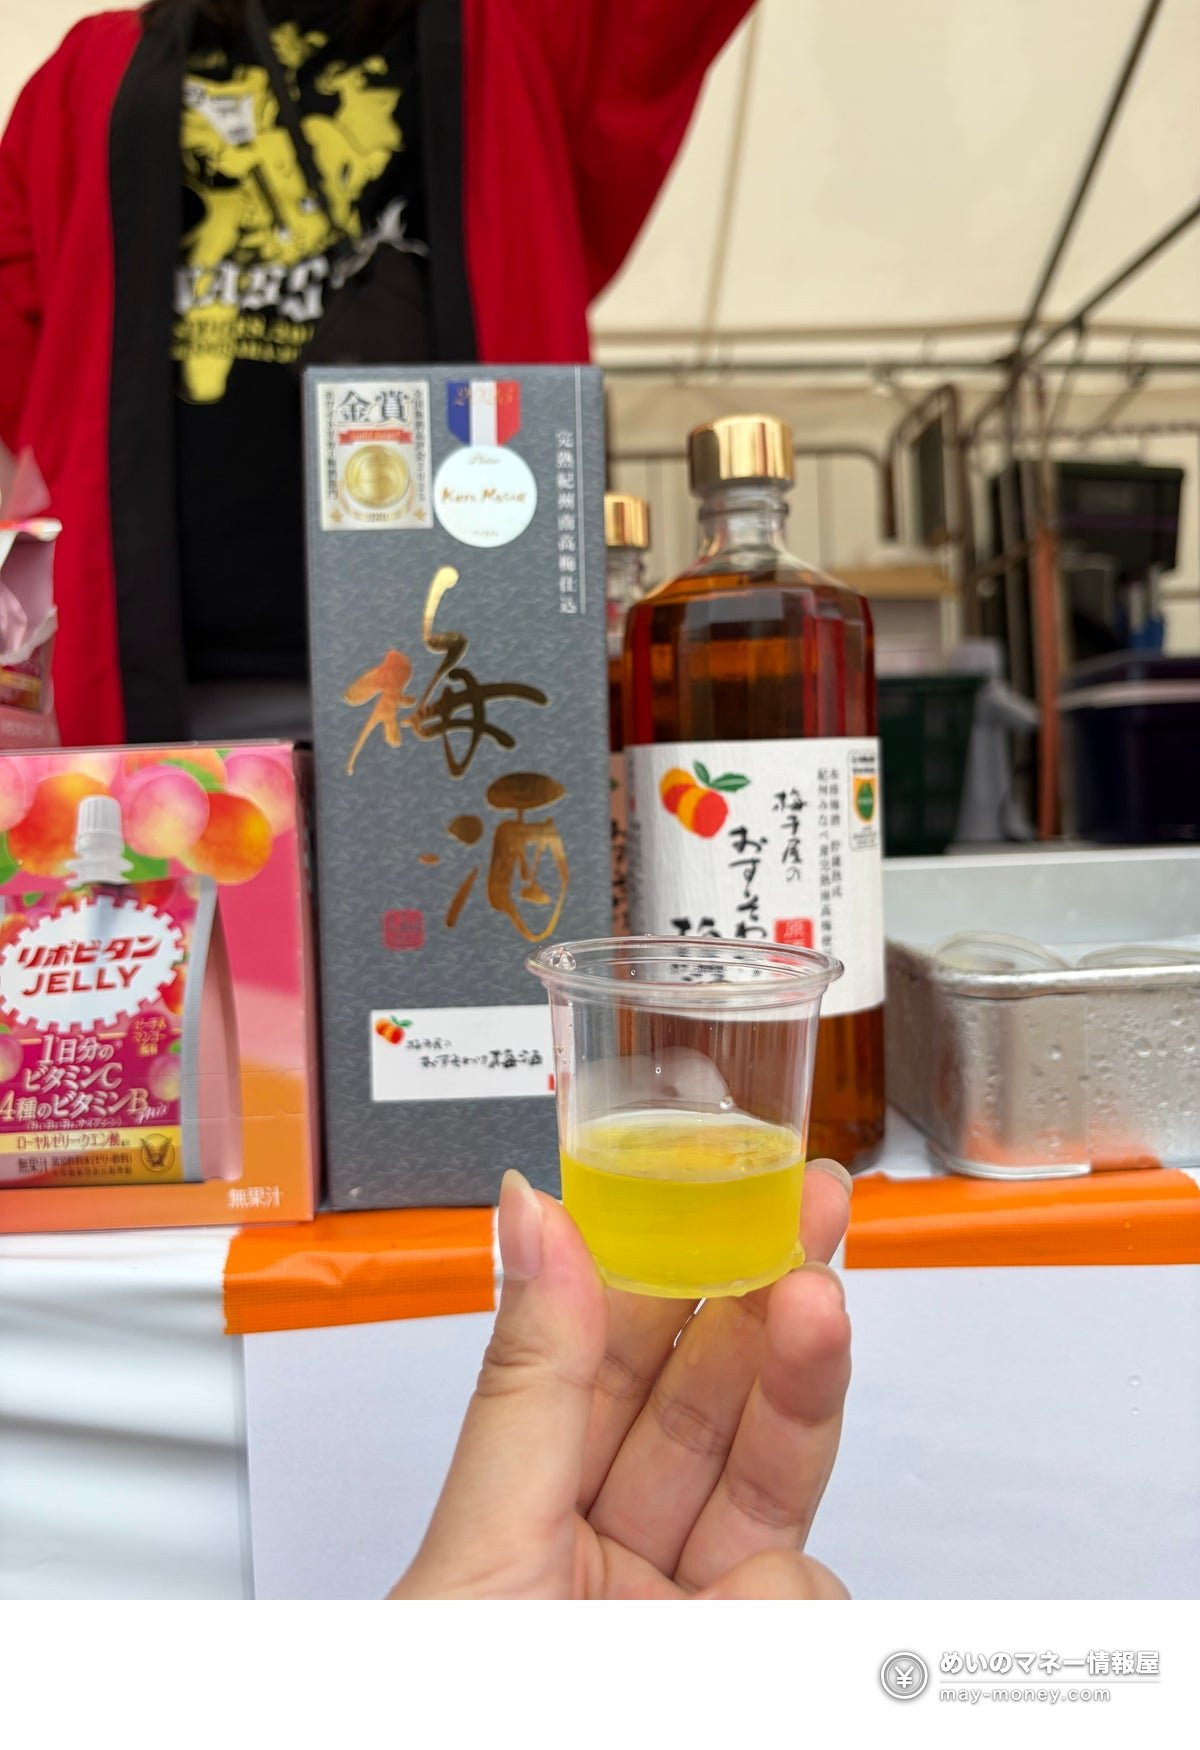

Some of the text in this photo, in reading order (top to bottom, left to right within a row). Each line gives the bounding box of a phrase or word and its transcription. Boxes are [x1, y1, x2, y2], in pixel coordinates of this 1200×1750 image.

[339, 390, 410, 422] 金賞
[556, 431, 577, 614] 完熟紀州南高梅仕込
[344, 566, 570, 942] 梅酒
[18, 937, 160, 967] リポビタン
[22, 966, 140, 995] JELLY
[38, 1035, 115, 1064] 1日分の
[24, 1062, 123, 1093] ビタミンC
[0, 1088, 149, 1121] 4種のビタミンB
[227, 1186, 283, 1208] 無果汁
